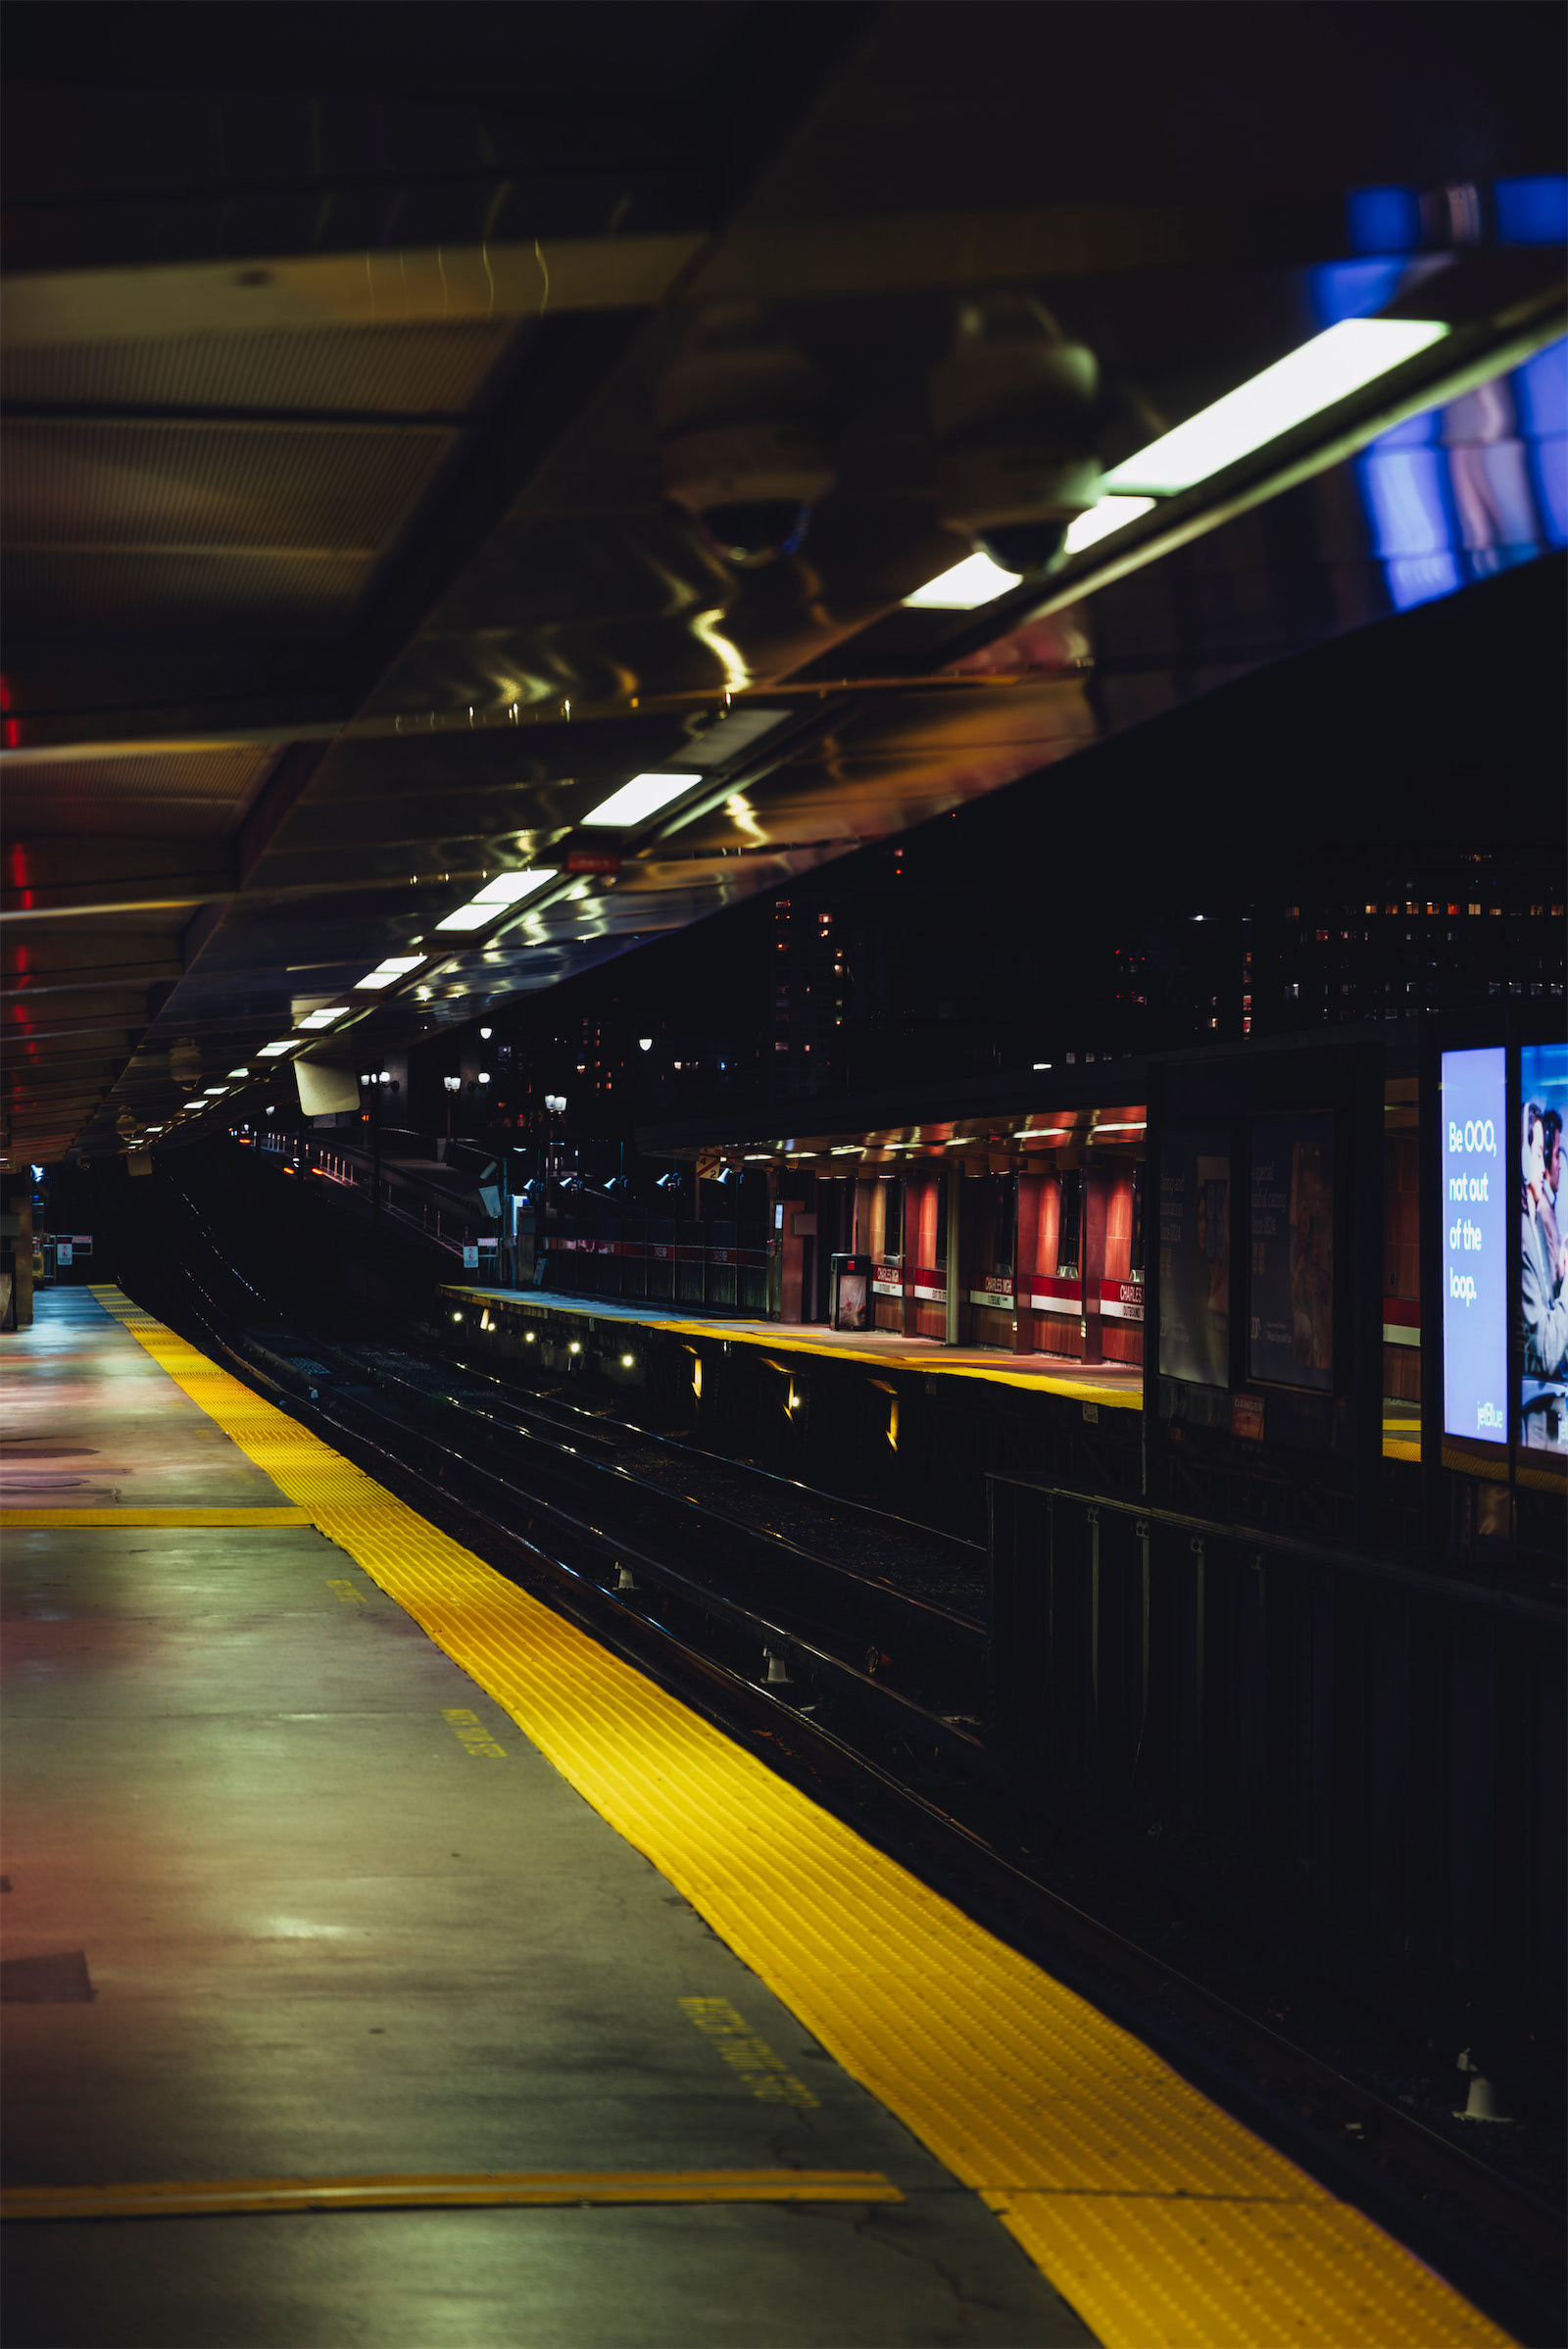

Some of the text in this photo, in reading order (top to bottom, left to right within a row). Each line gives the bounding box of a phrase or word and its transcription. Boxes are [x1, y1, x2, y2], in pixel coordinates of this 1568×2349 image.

[1448, 1119, 1497, 1157] Be OOO,
[700, 1156, 707, 1166] 4
[710, 1169, 716, 1179] 2
[1448, 1171, 1489, 1201] not out
[1449, 1218, 1482, 1250] of the
[1119, 1284, 1143, 1303] CHARLES
[1449, 1267, 1477, 1307] loop.
[1234, 1397, 1263, 1413] DANGER
[1476, 1400, 1503, 1430] jetBlue
